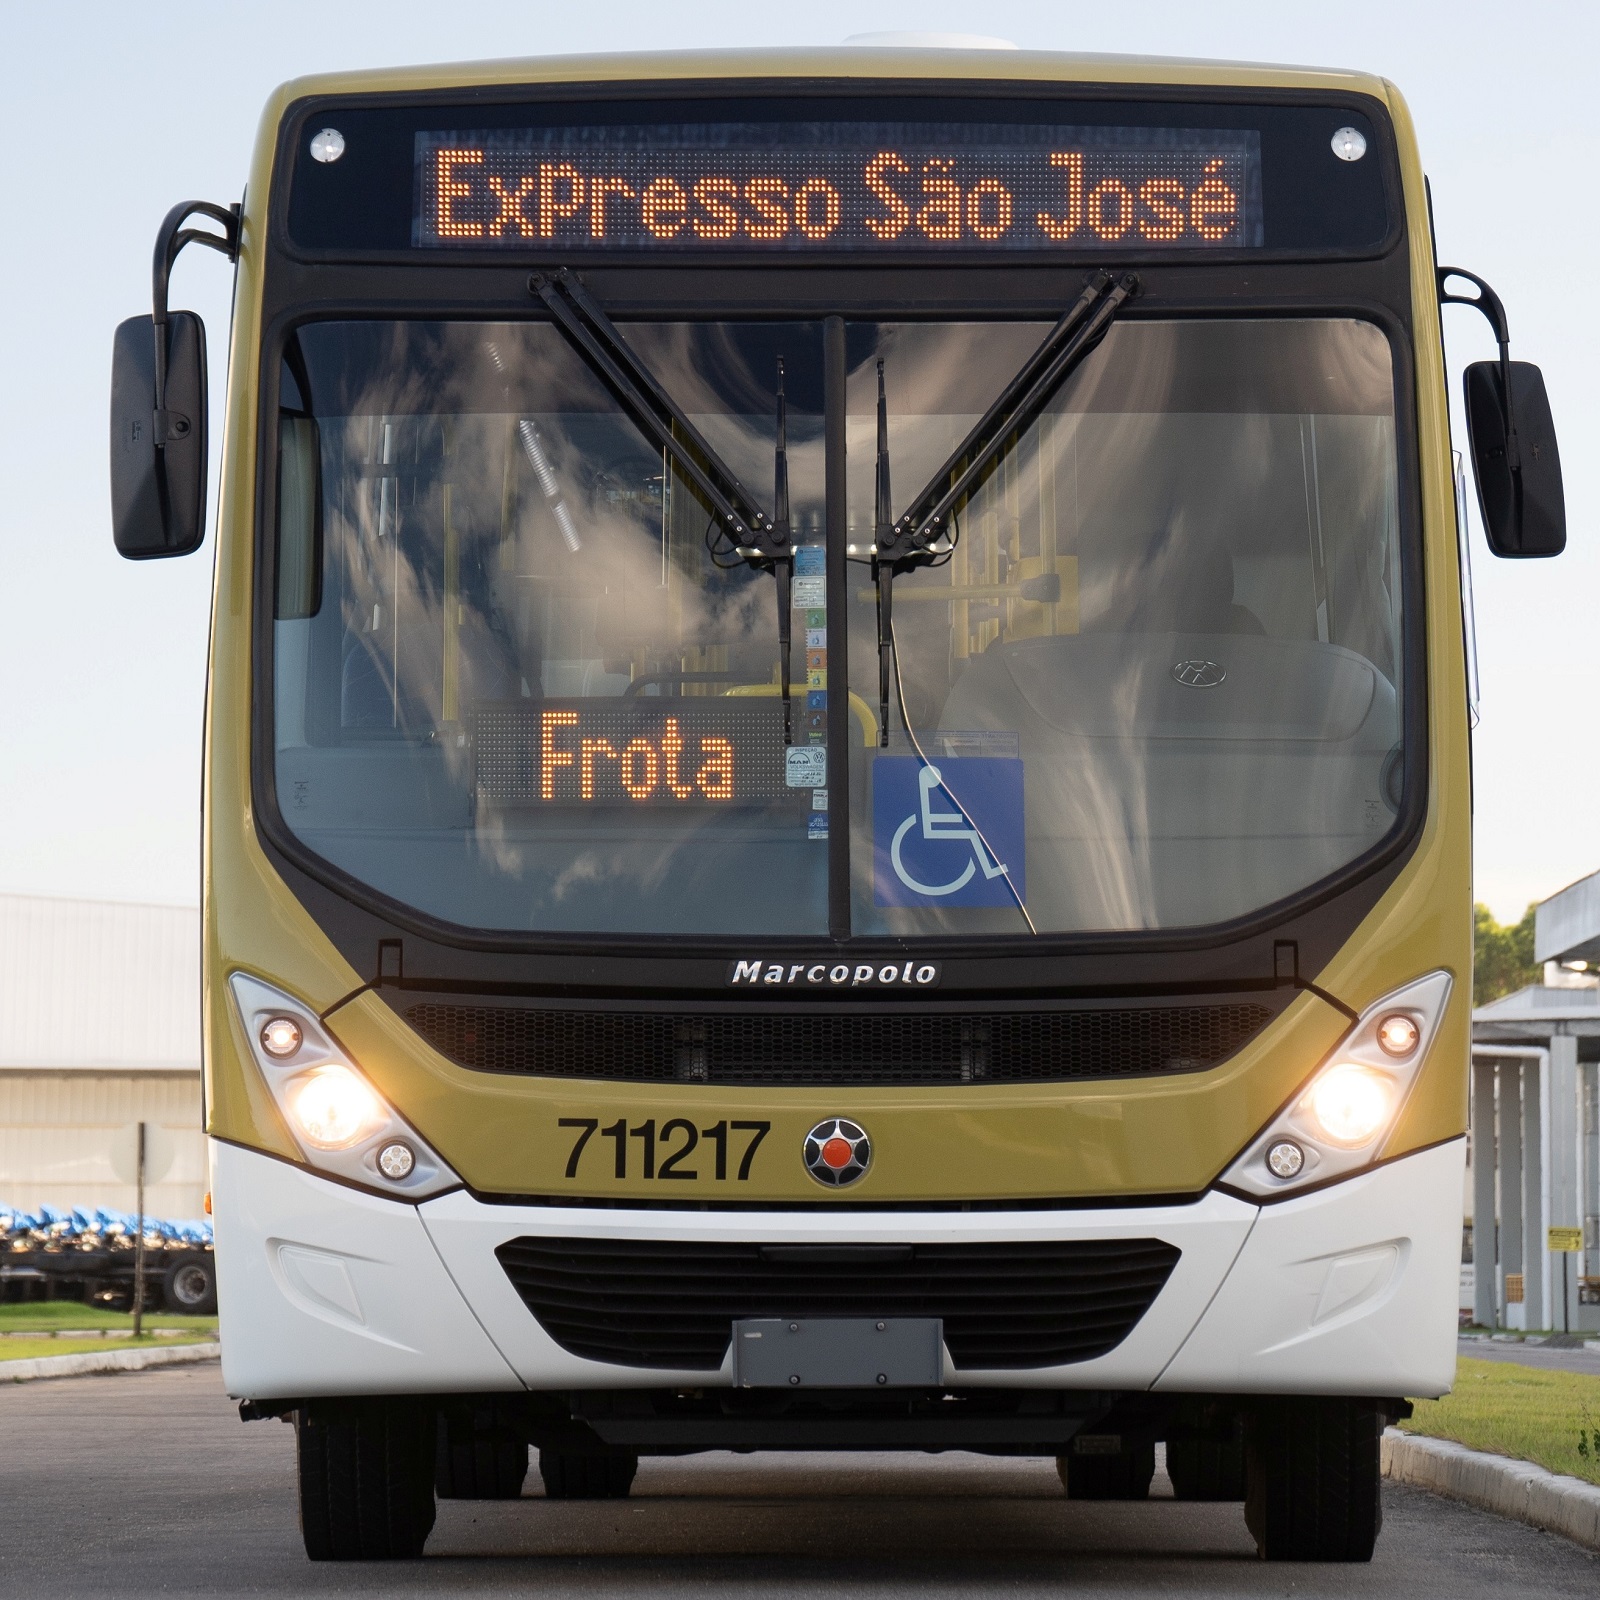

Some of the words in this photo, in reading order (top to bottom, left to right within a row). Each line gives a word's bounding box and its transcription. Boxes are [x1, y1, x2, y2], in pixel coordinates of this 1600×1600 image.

[865, 151, 1012, 240] São
[1037, 152, 1236, 240] José
[541, 711, 733, 800] Frota
[732, 960, 937, 987] Marcopolo
[558, 1118, 771, 1181] 711217
